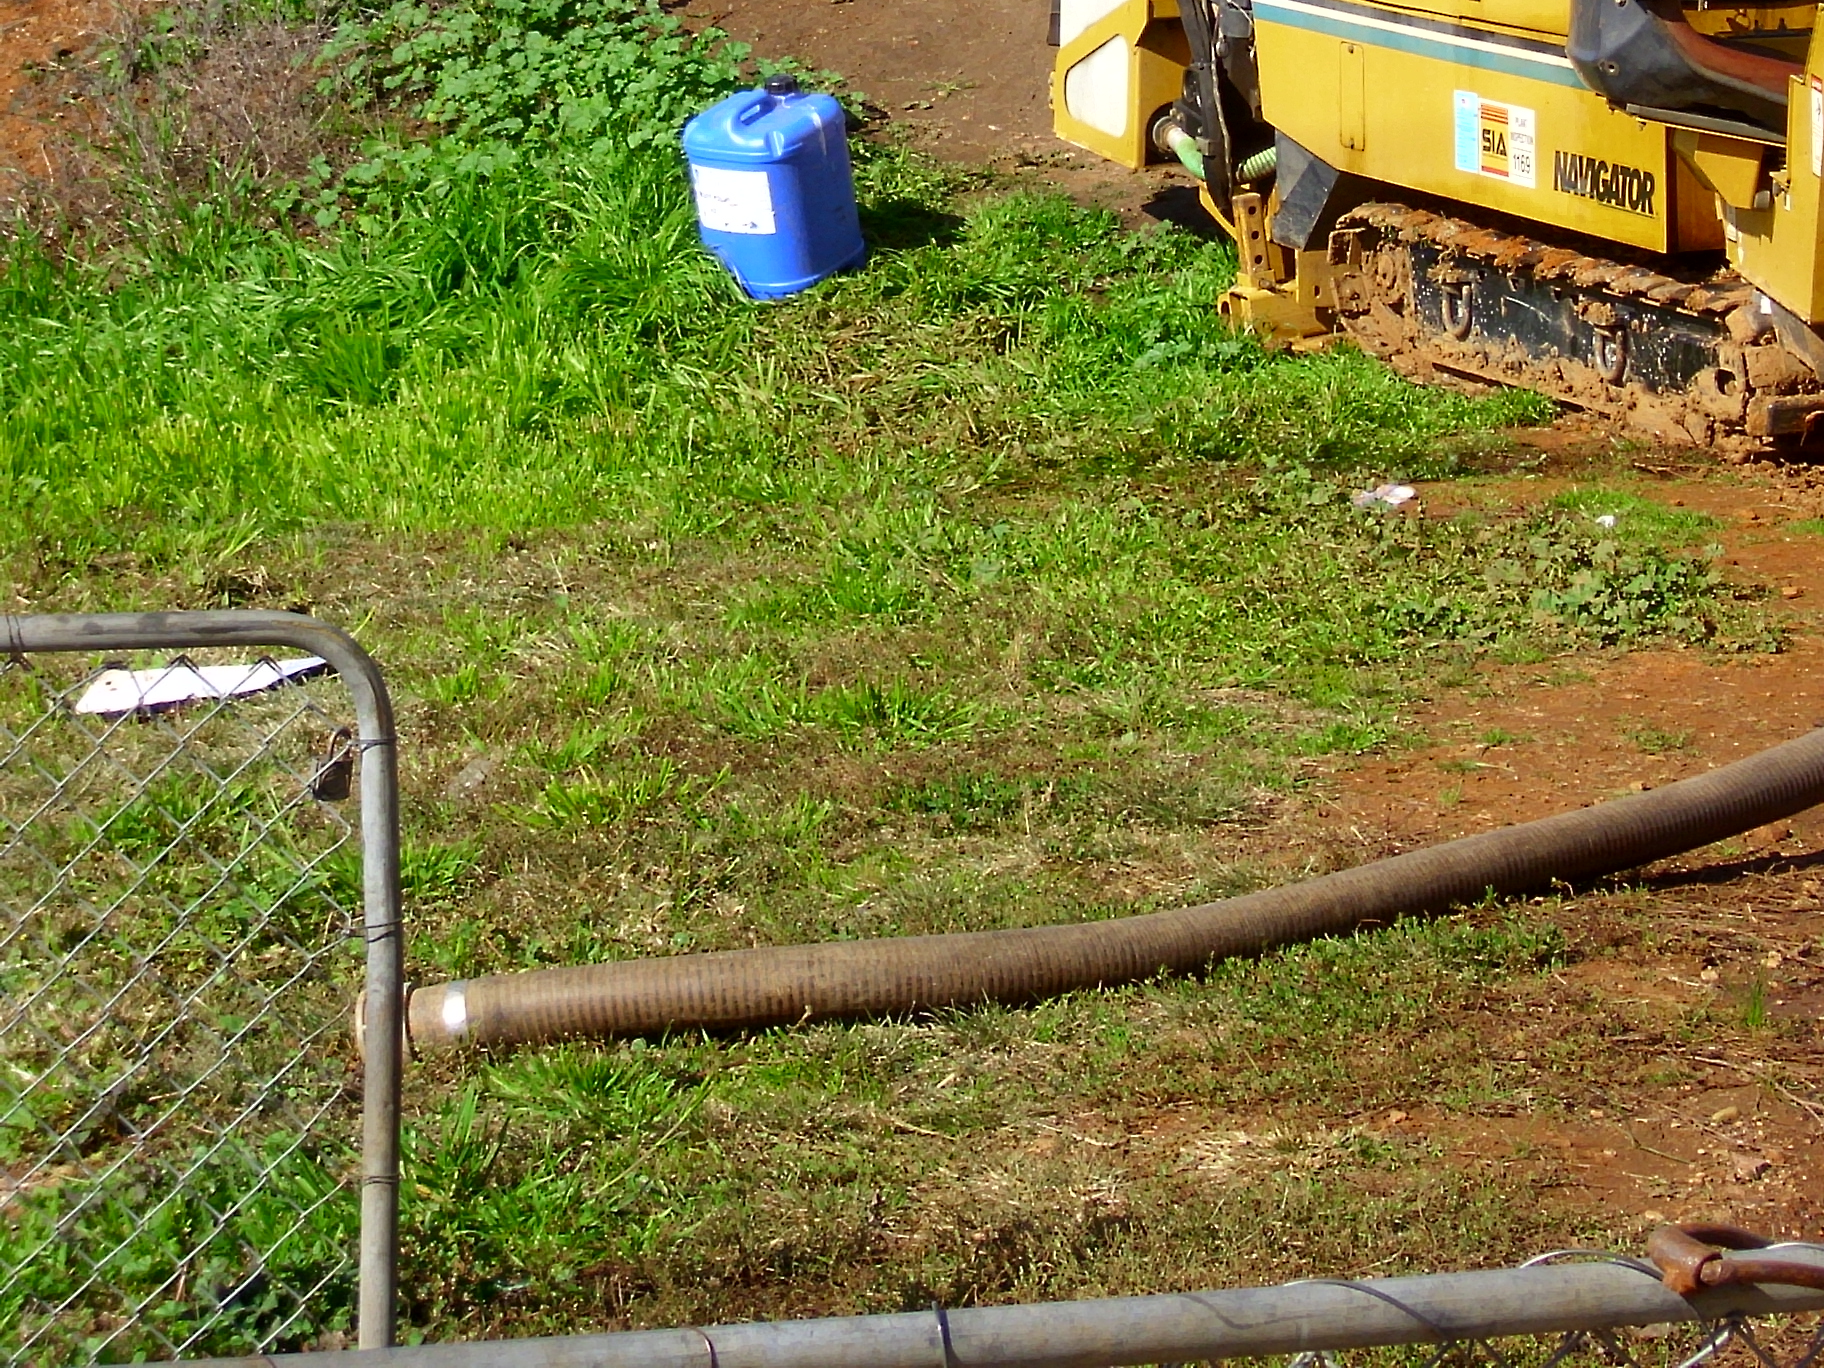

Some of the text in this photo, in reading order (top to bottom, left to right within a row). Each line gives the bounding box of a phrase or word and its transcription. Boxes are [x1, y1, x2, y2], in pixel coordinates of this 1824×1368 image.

[1482, 128, 1507, 157] SIA
[1513, 153, 1531, 174] 1169
[1553, 151, 1655, 215] NAVIGATOR
